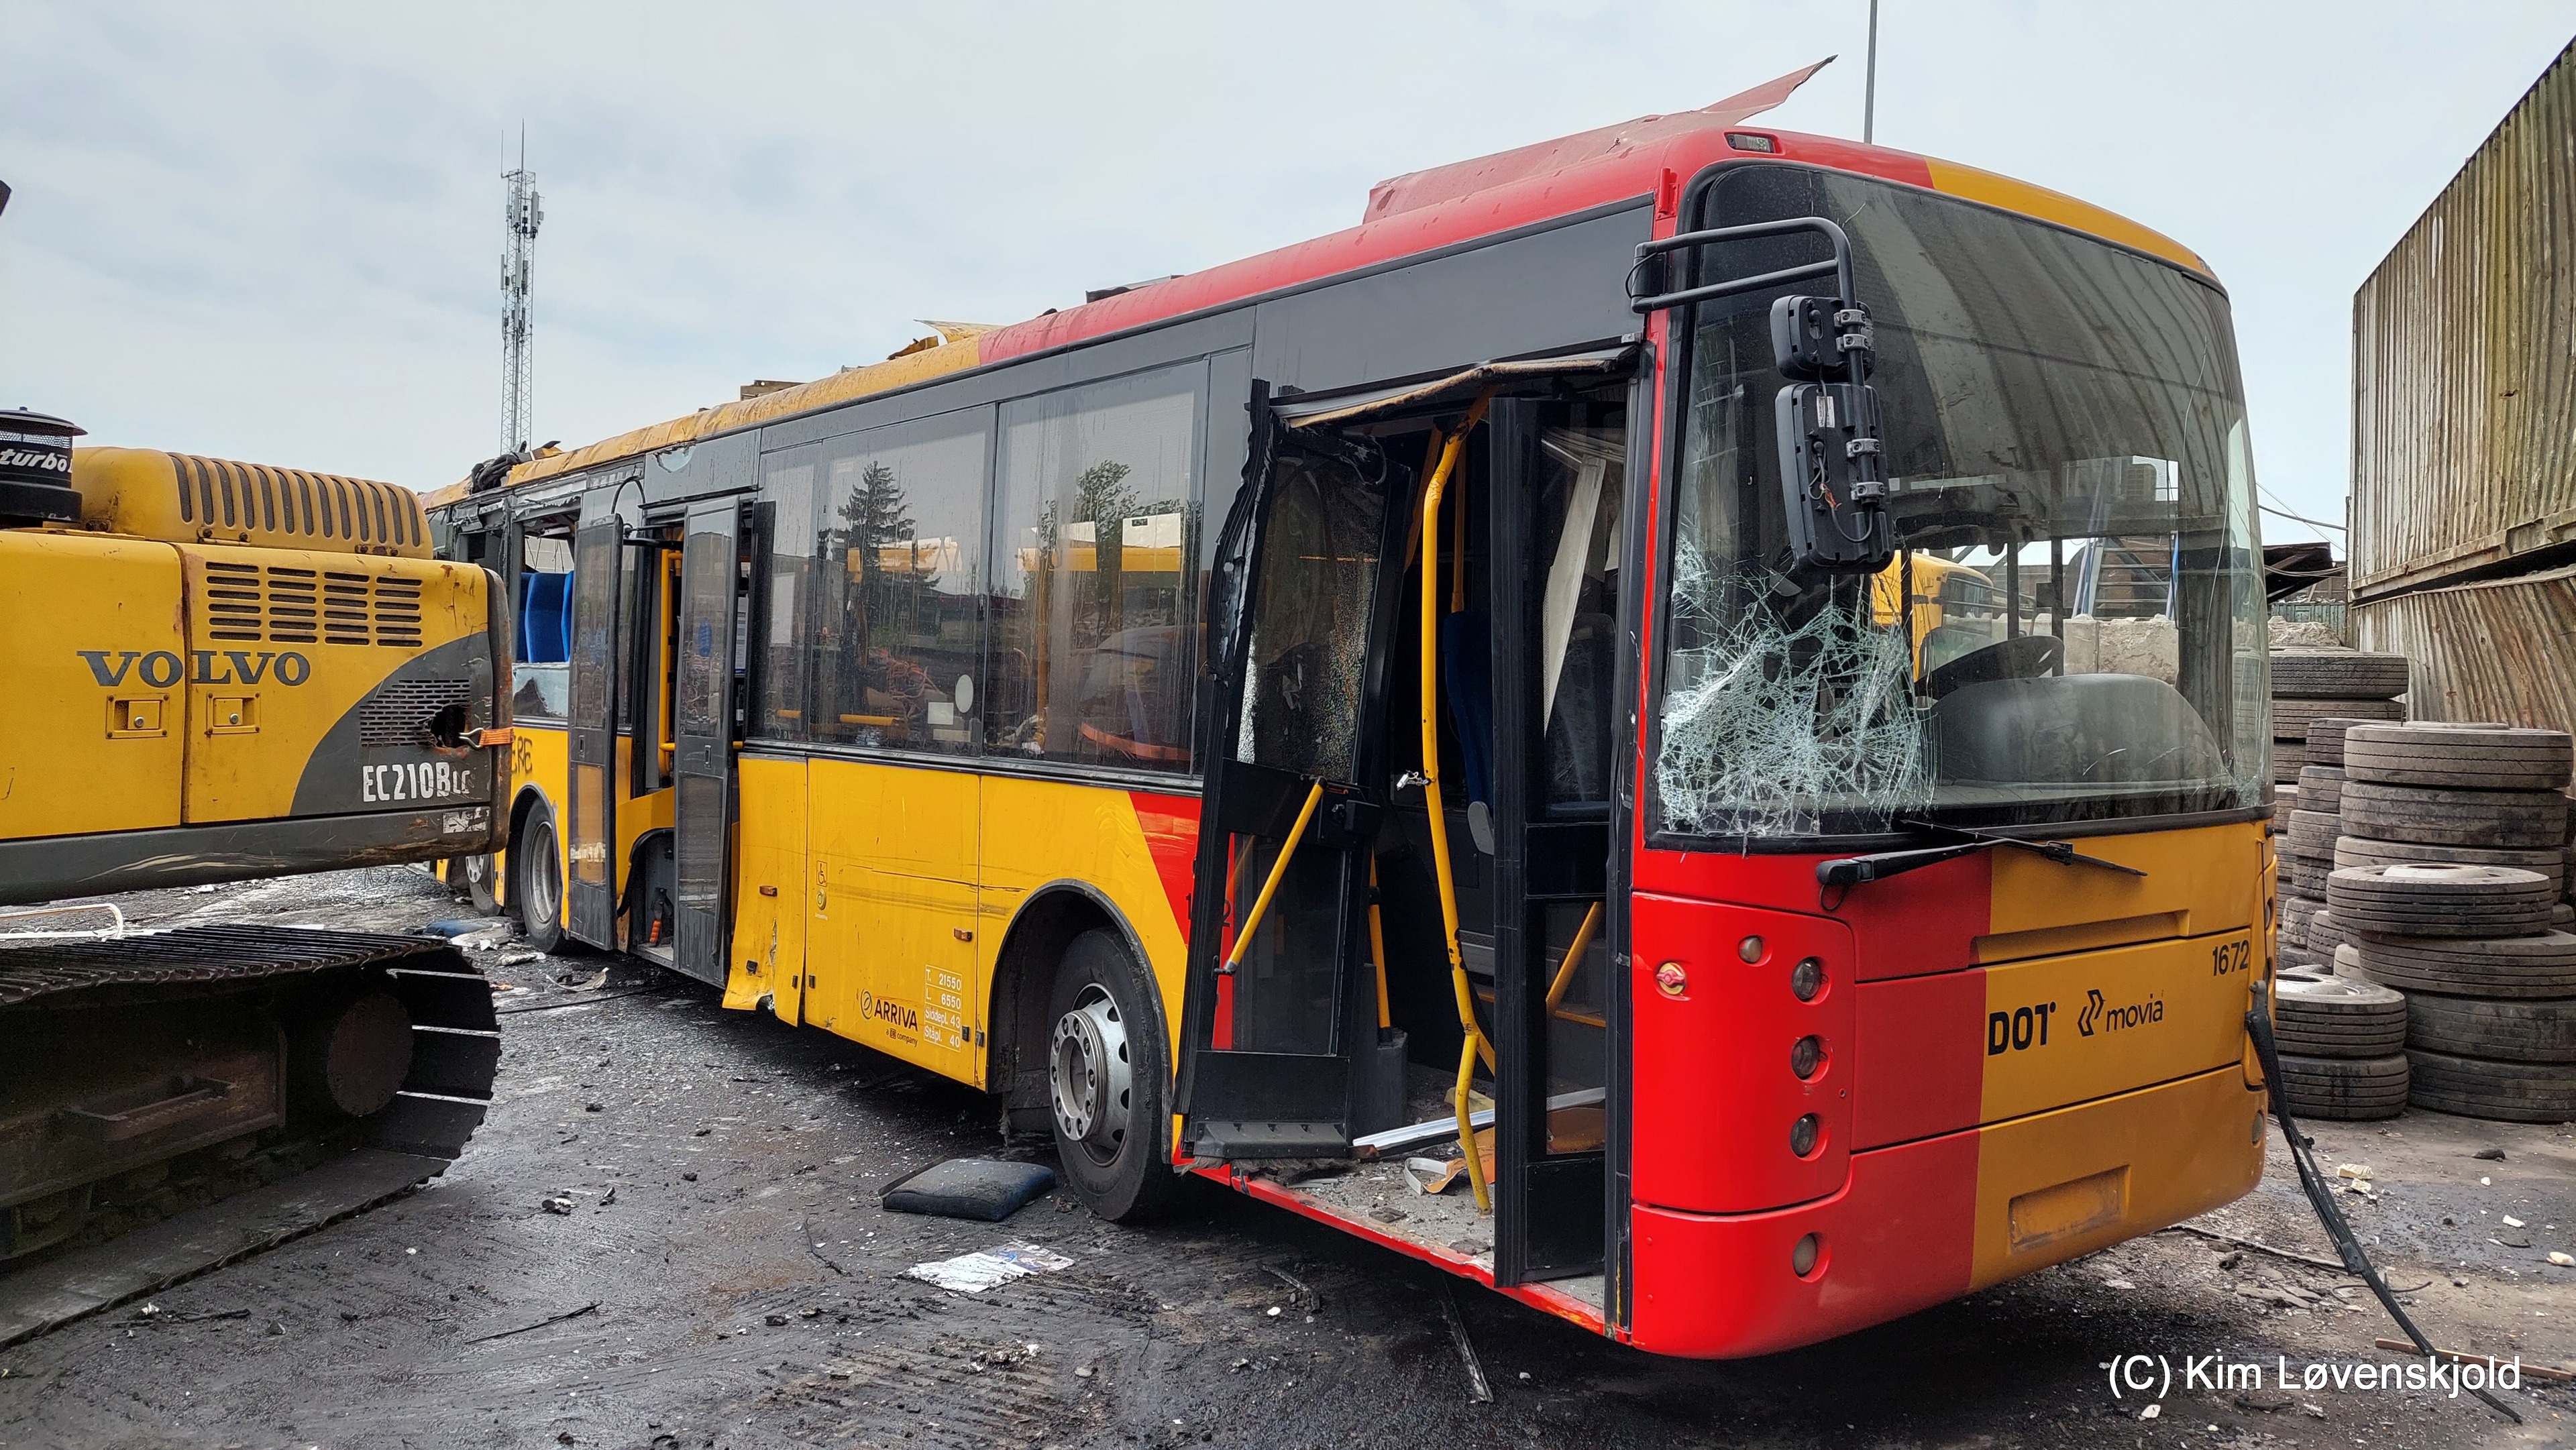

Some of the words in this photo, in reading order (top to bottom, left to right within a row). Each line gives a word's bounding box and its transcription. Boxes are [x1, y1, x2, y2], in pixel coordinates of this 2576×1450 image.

[77, 651, 311, 688] VOLVO
[2211, 939, 2250, 977] 1672
[938, 973, 961, 991] 21550
[941, 993, 961, 1010] 6550
[2106, 993, 2164, 1032] movia
[874, 999, 918, 1032] ARRIVA
[950, 1015, 961, 1029] 43
[897, 1032, 918, 1048] company
[949, 1034, 960, 1048] 40
[1988, 1002, 2050, 1056] DOT
